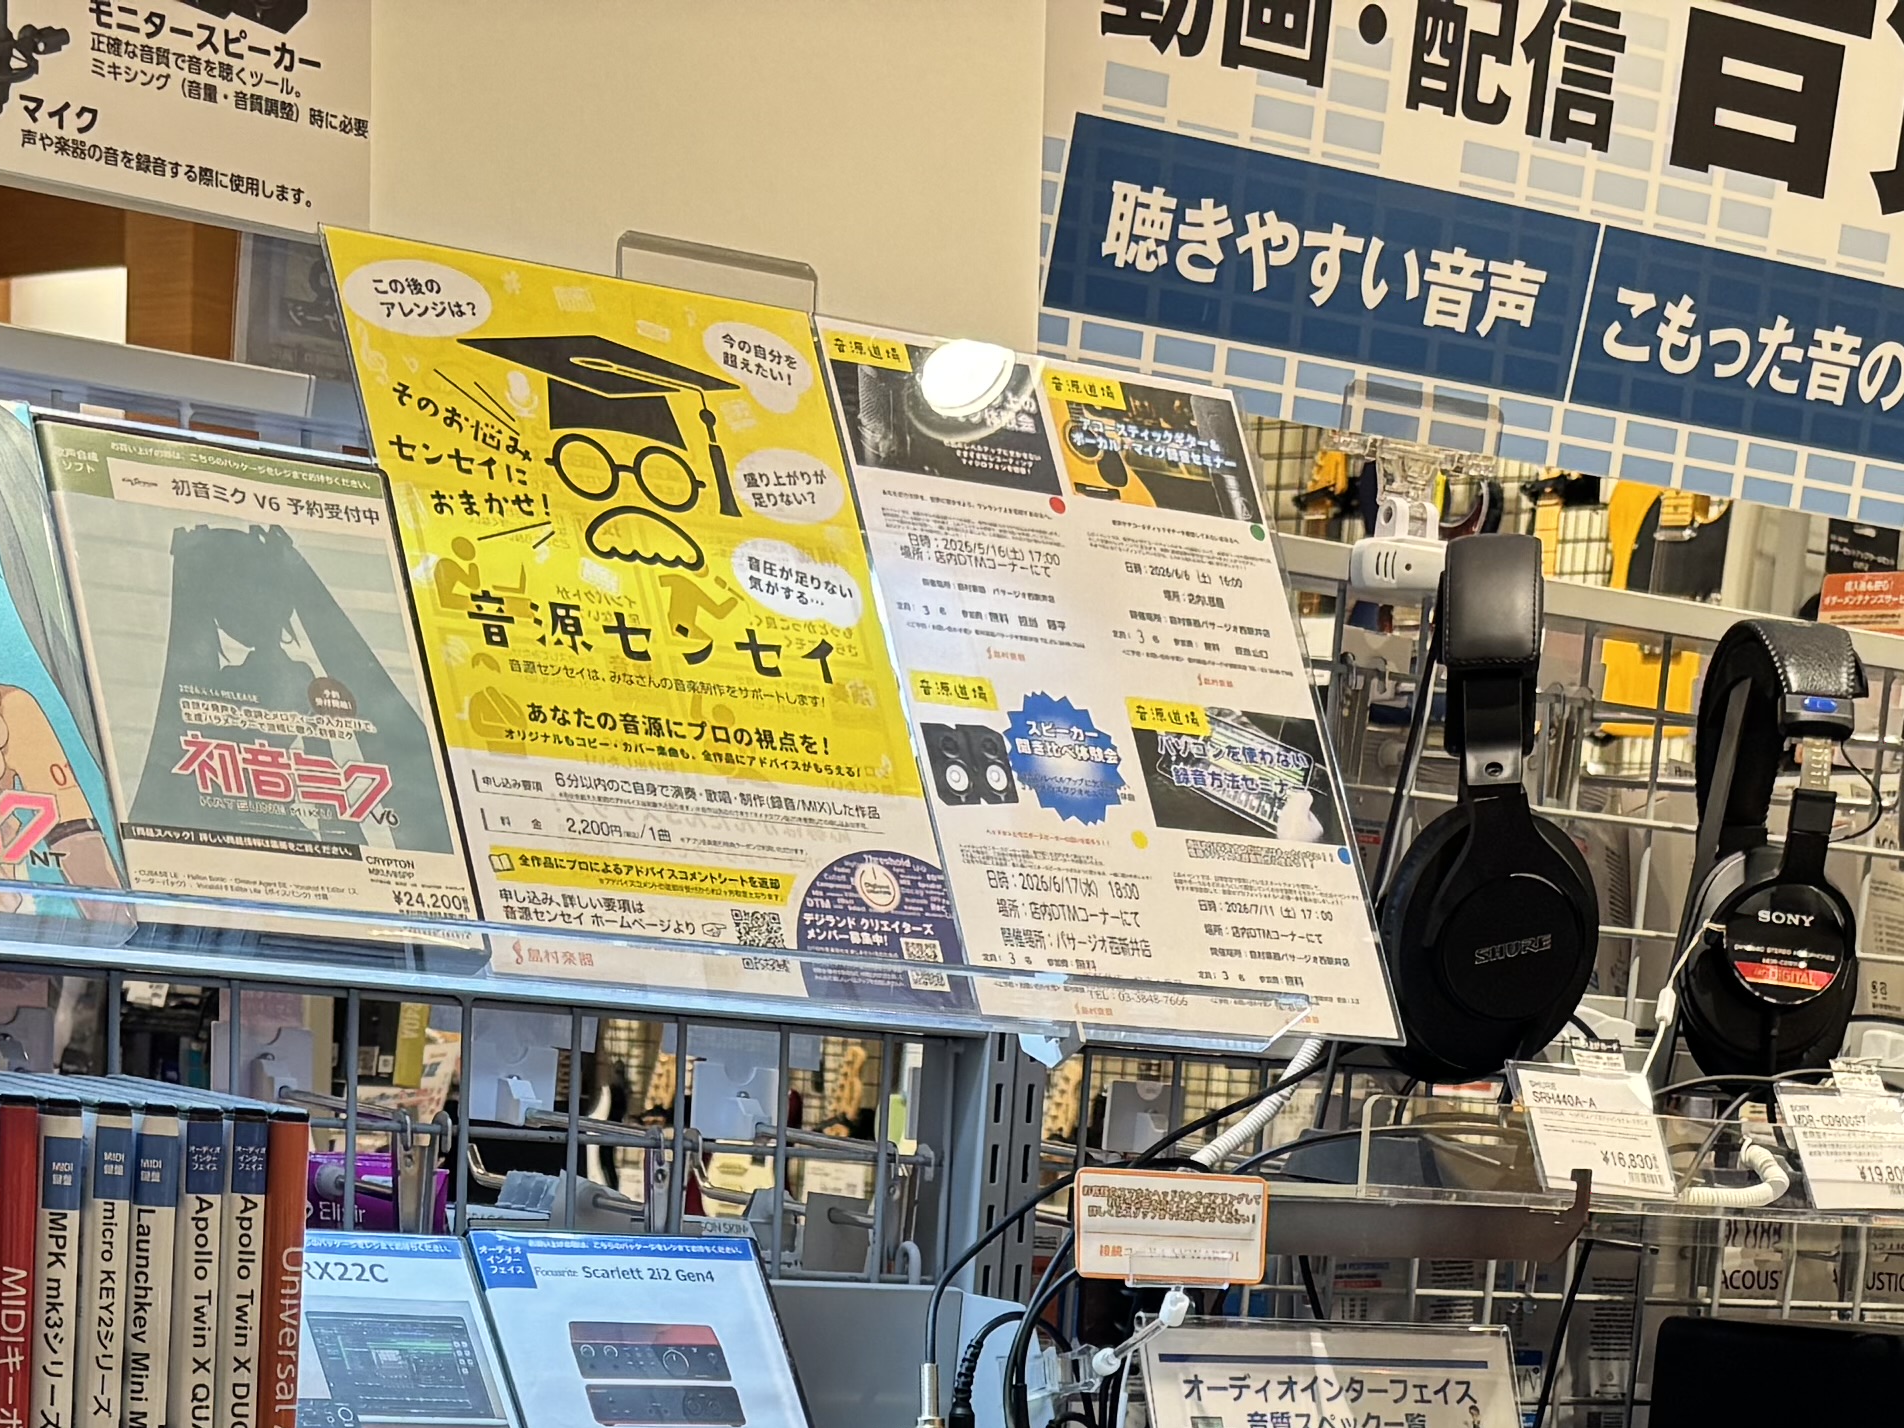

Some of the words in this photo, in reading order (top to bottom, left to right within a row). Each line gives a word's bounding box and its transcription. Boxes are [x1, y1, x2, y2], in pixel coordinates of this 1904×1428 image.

[90, 32, 302, 98] 正確な音質で音を聴くツール。
[20, 94, 98, 134] マイク
[21, 130, 314, 208] 声や楽器の音を録音する際に使用します。
[1101, 180, 1547, 338] 聴きやすい音声
[721, 332, 797, 371] 今の自分を
[1052, 377, 1116, 402] 音源道場
[743, 468, 826, 489] 盛り上がりが
[747, 556, 853, 602] 音圧が足りない
[467, 591, 835, 684] 音源センセイ
[526, 701, 829, 756] あなたの音源にプロの視点を!
[1027, 722, 1098, 740] スピーカー
[172, 732, 392, 823] 初音ミク
[1158, 738, 1309, 771] パソコンを使わない
[1758, 911, 1815, 928] SONY
[1474, 934, 1552, 966] SHURE
[48, 1212, 67, 1269] MPK
[130, 1208, 156, 1345] Launchkey
[582, 1265, 643, 1280] Scarlett
[648, 1267, 671, 1281] 2i2
[675, 1268, 715, 1283] Gen4
[274, 1247, 304, 1413] Universal
[130, 1352, 150, 1402] Mini
[1184, 1375, 1478, 1404] オーディオインターフェイス
